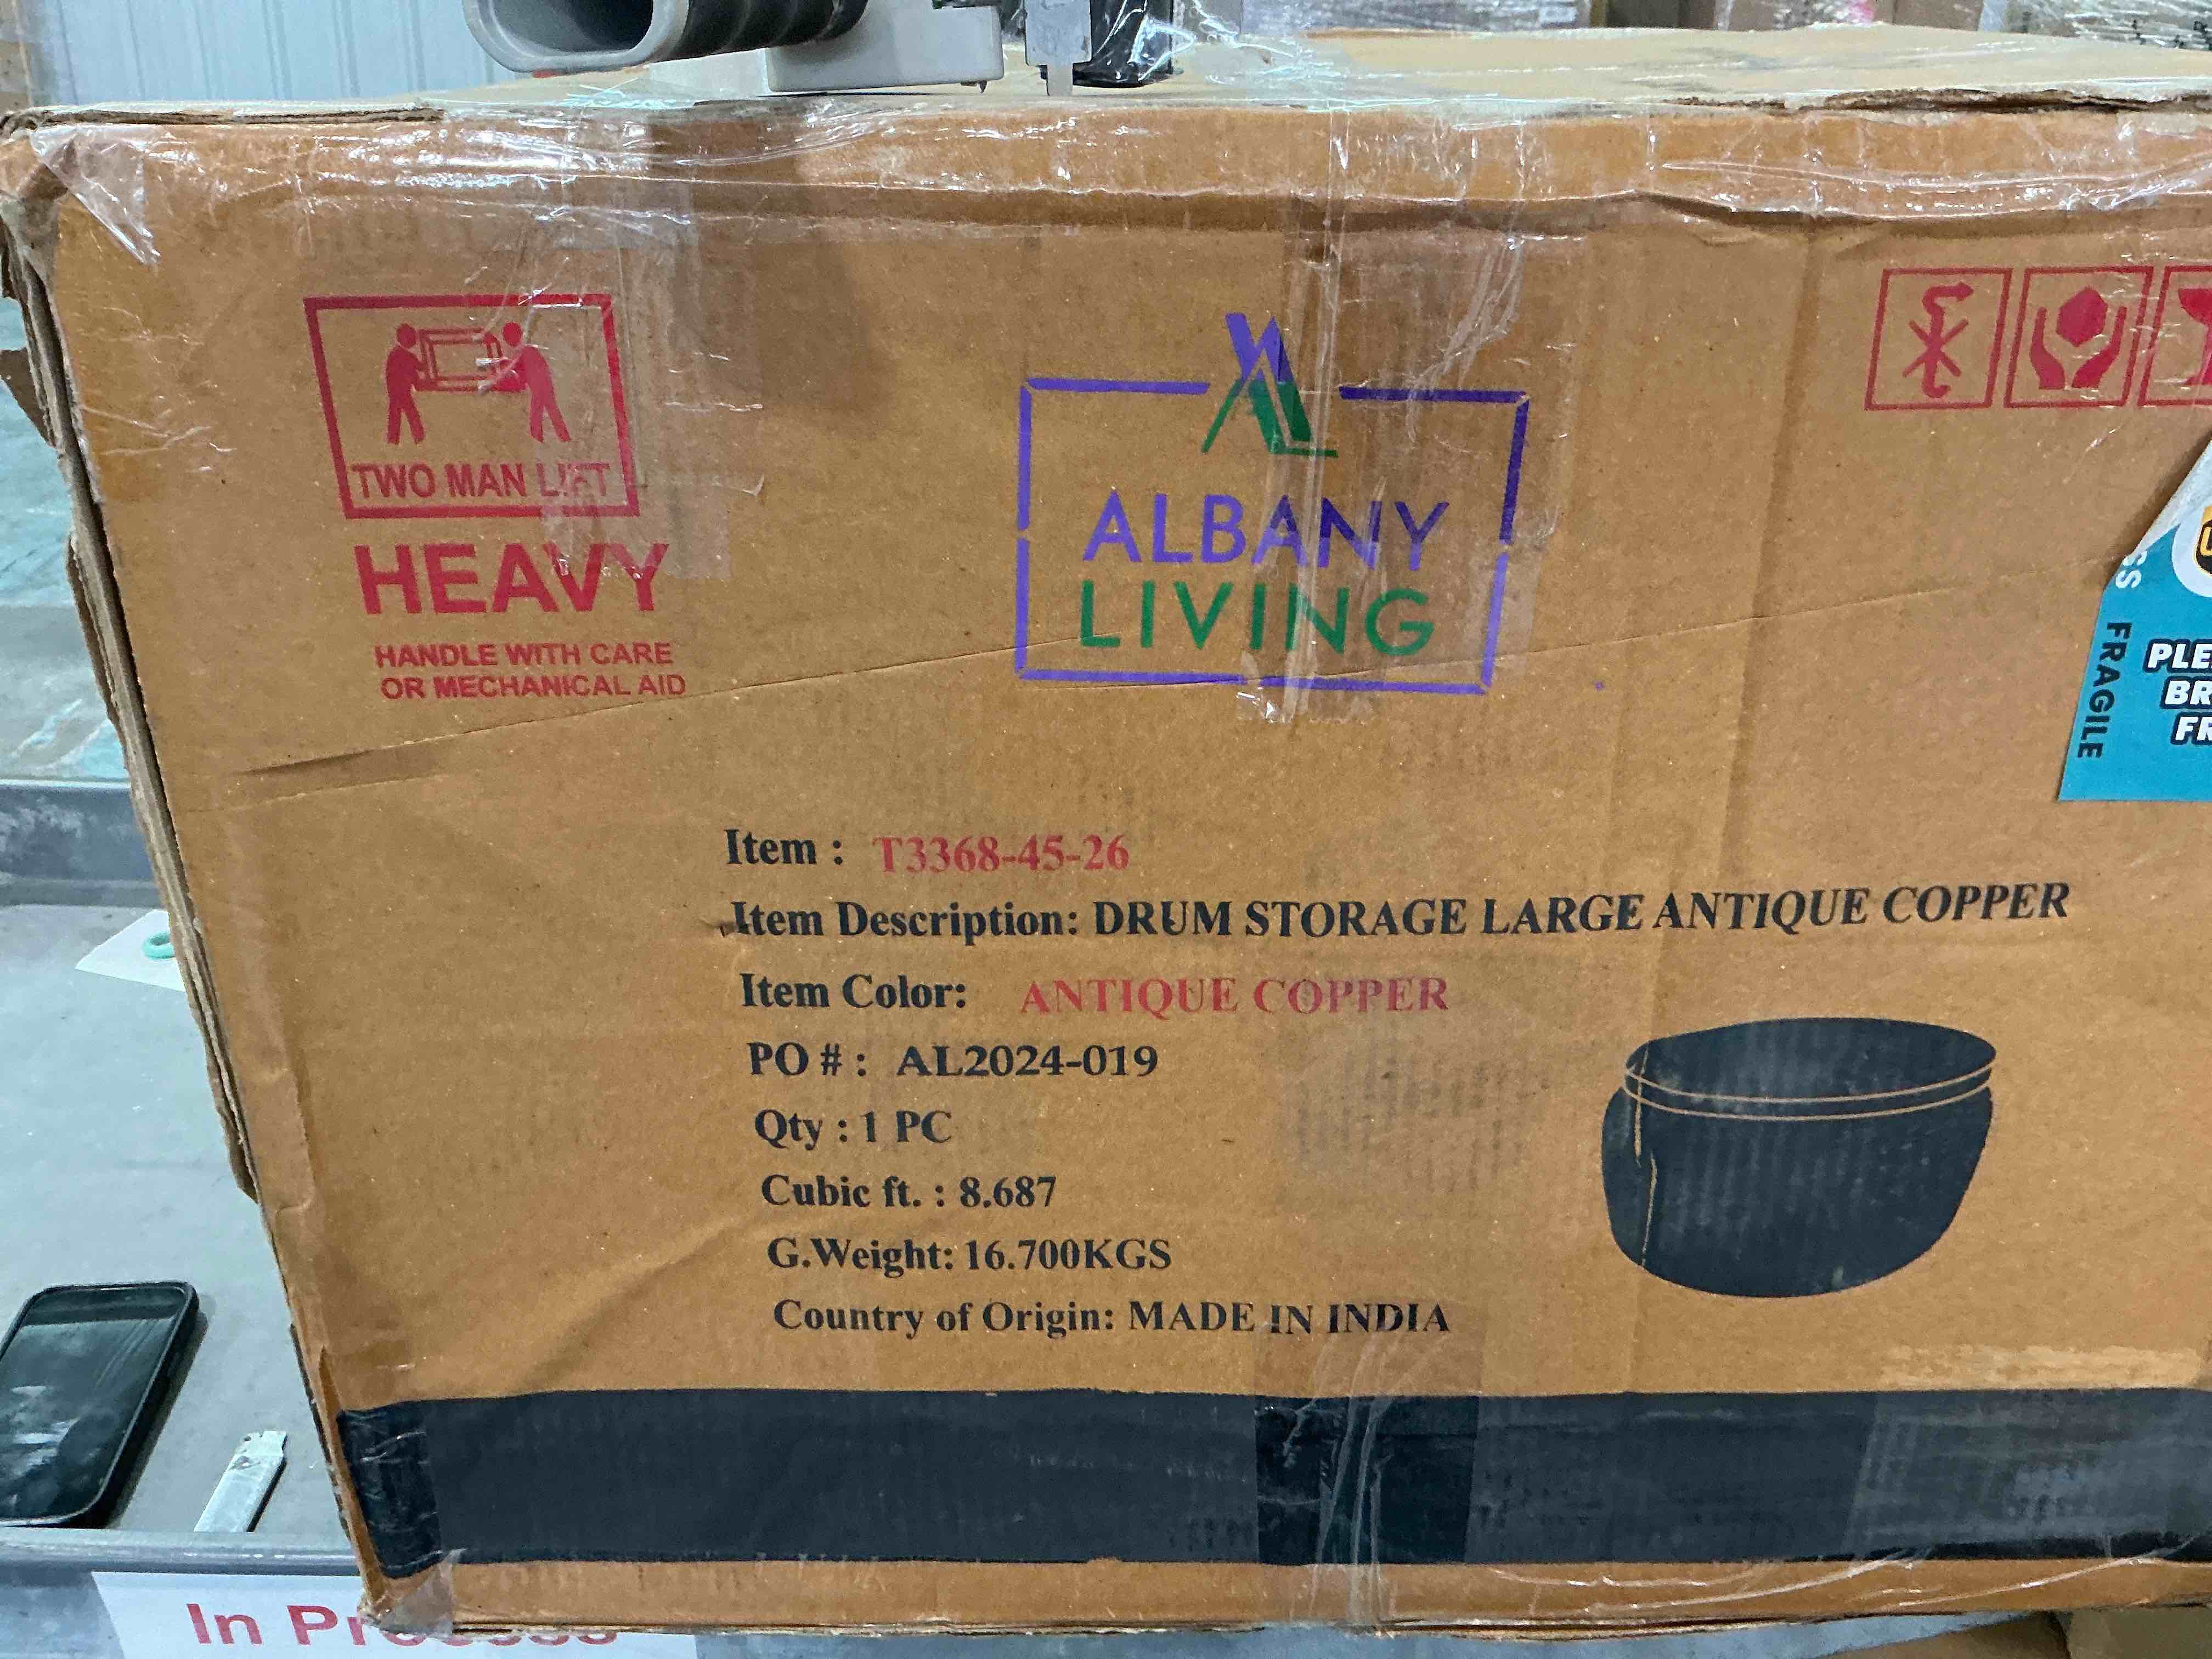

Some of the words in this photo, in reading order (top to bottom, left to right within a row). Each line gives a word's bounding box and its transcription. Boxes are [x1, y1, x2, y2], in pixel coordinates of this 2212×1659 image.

[352, 464, 435, 498] TWO
[445, 463, 526, 498] MAN
[1083, 490, 1450, 571] ALBANY
[353, 543, 670, 614] HEAVY
[1079, 580, 1434, 656] LIVING
[374, 644, 498, 668] HANDLE
[505, 643, 580, 665] WITH
[590, 642, 674, 665] CARE
[381, 676, 425, 699] OR
[434, 675, 631, 699] MECHANICAL
[638, 674, 686, 696] AID
[2076, 622, 2132, 759] FRAGILE
[724, 829, 817, 865] Item
[873, 834, 1130, 873] T3368-45-26
[731, 901, 823, 936] Item
[834, 901, 1077, 946] Description:
[1093, 900, 1232, 935] DRUM
[1245, 898, 1467, 937] STORAGE
[1480, 894, 1644, 935] LARGE
[1651, 888, 1871, 935] ANTIQUE
[1883, 882, 2070, 923] COPPER
[740, 973, 830, 1007] Item
[843, 974, 966, 1009] Color:
[1020, 978, 1238, 1020] ANTIQUE
[1252, 977, 1448, 1014] COPPER
[748, 1042, 809, 1076] PO
[896, 1044, 1159, 1077] AL2024-019
[754, 1109, 823, 1150] Qty
[861, 1111, 876, 1142] 1
[896, 1110, 952, 1143] PC
[761, 1174, 871, 1207] Cubic
[883, 1176, 921, 1207] ft.
[960, 1176, 1057, 1207] 8.687
[769, 1237, 953, 1278] G.Weight:
[965, 1239, 1172, 1270] 16.700KGS
[774, 1299, 923, 1339] Country
[937, 1302, 973, 1331] of
[983, 1302, 1113, 1339] Origin:
[1129, 1301, 1255, 1331] MADE
[1270, 1305, 1312, 1334] IN
[1328, 1303, 1450, 1333] INDIA
[186, 1603, 263, 1645] In
